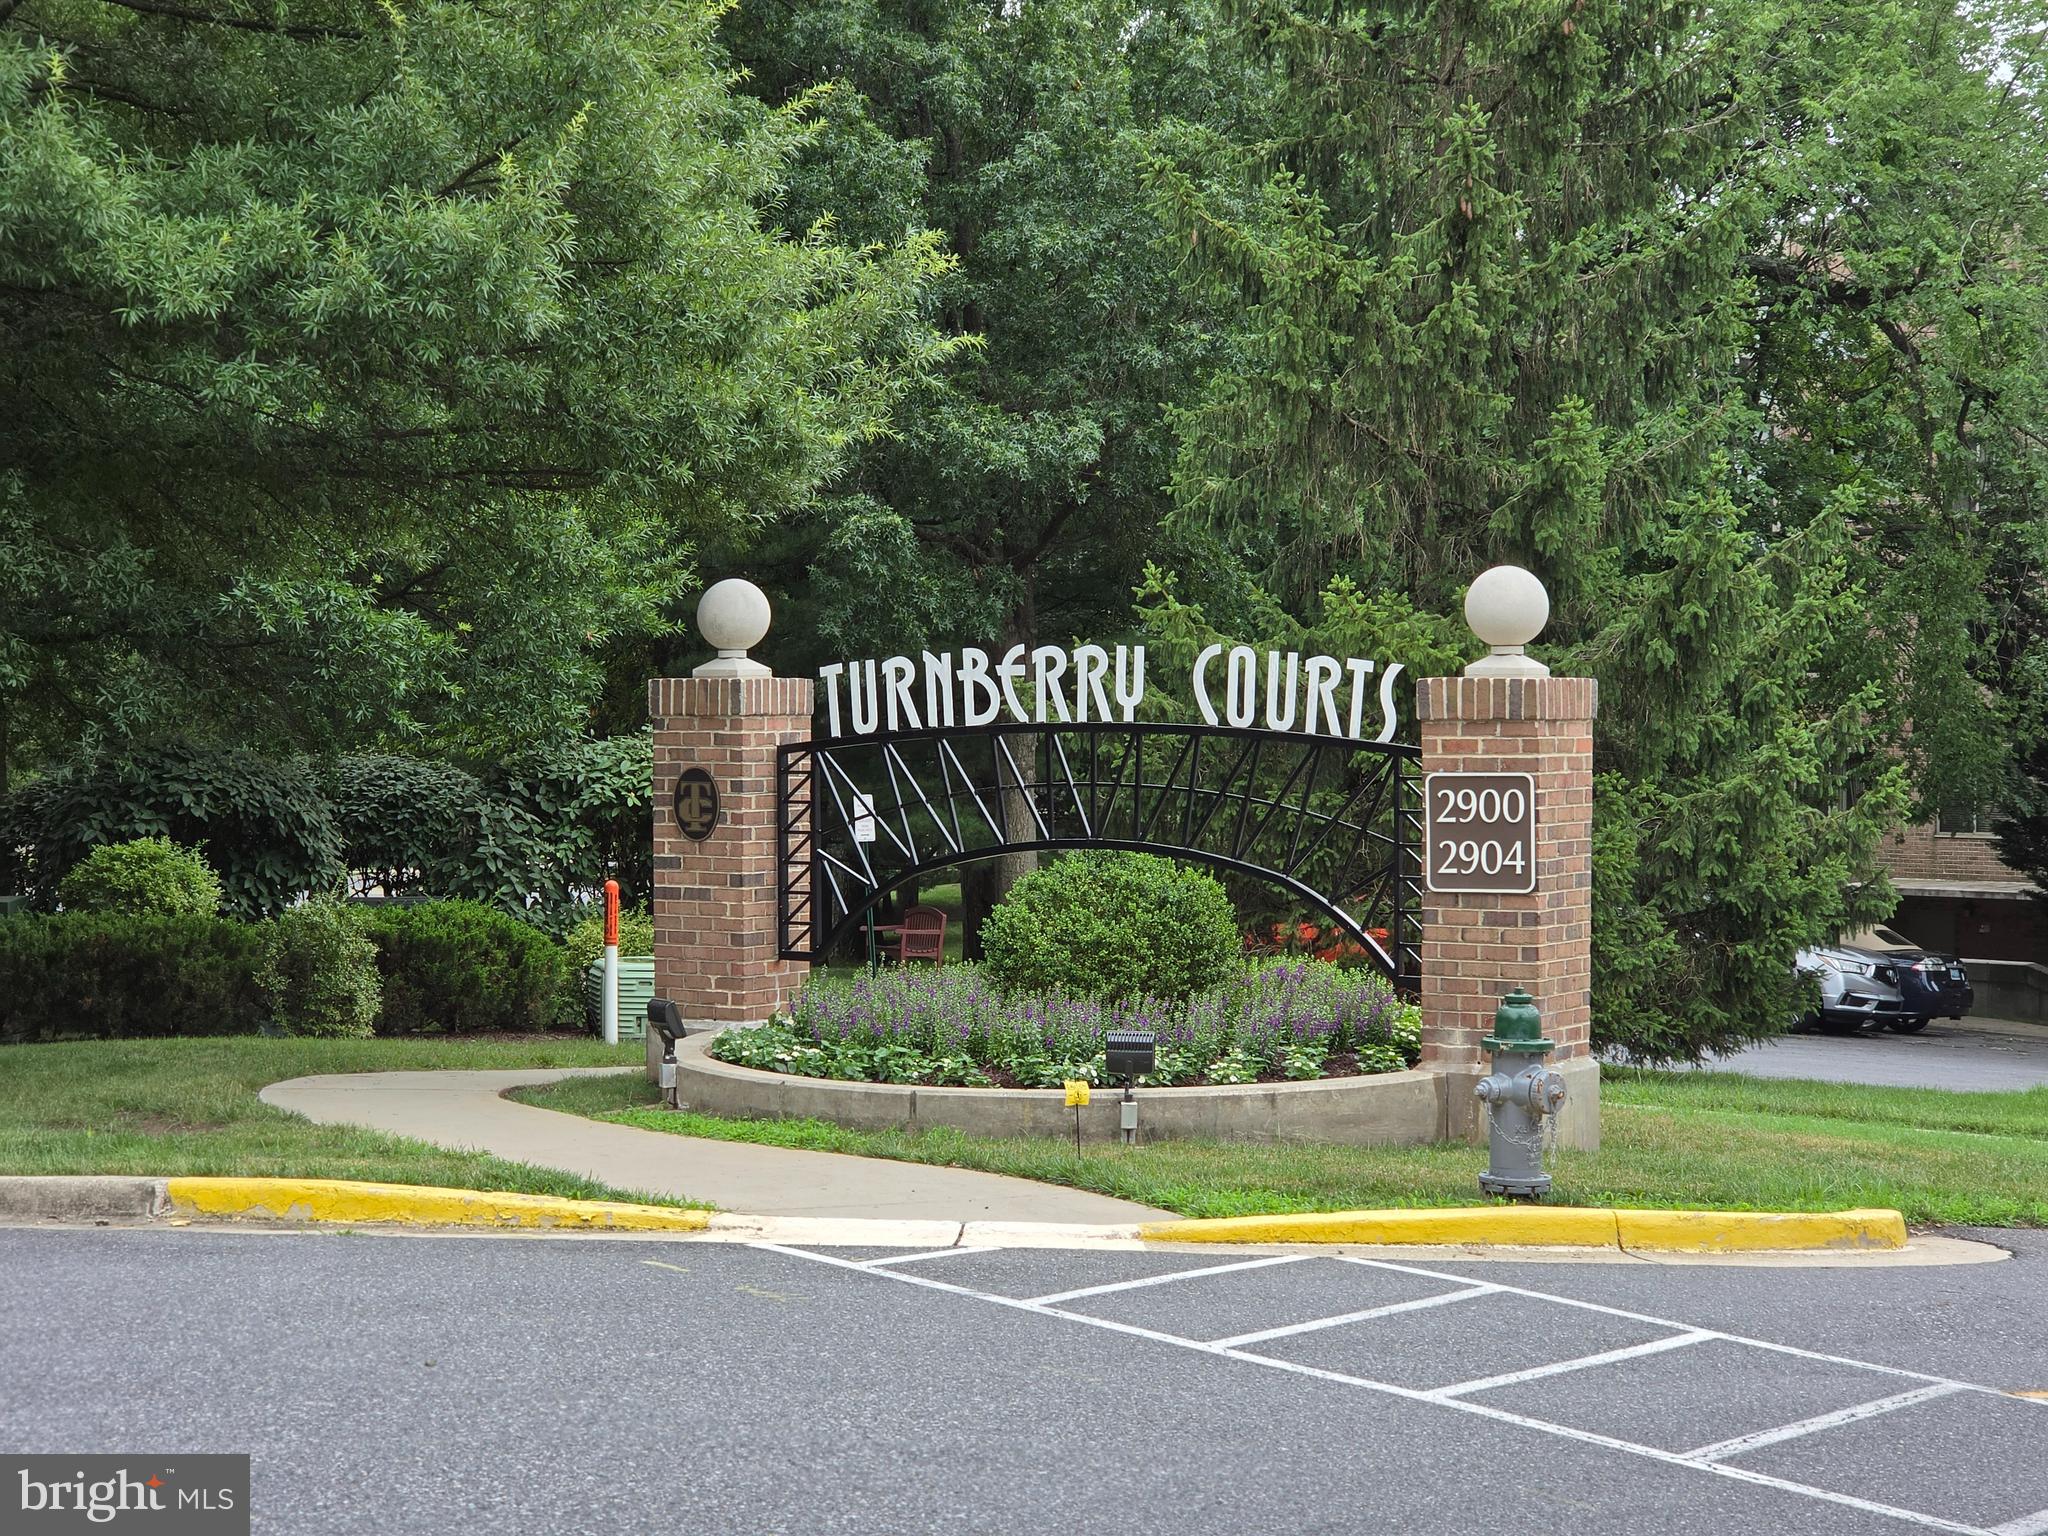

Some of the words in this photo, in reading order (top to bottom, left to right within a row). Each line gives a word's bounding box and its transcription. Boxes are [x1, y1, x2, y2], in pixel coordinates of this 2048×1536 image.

[819, 643, 1145, 738] TURNBERRY
[1193, 643, 1405, 743] COURTS
[1436, 789, 1525, 823] 2900
[1437, 840, 1526, 875] 2904
